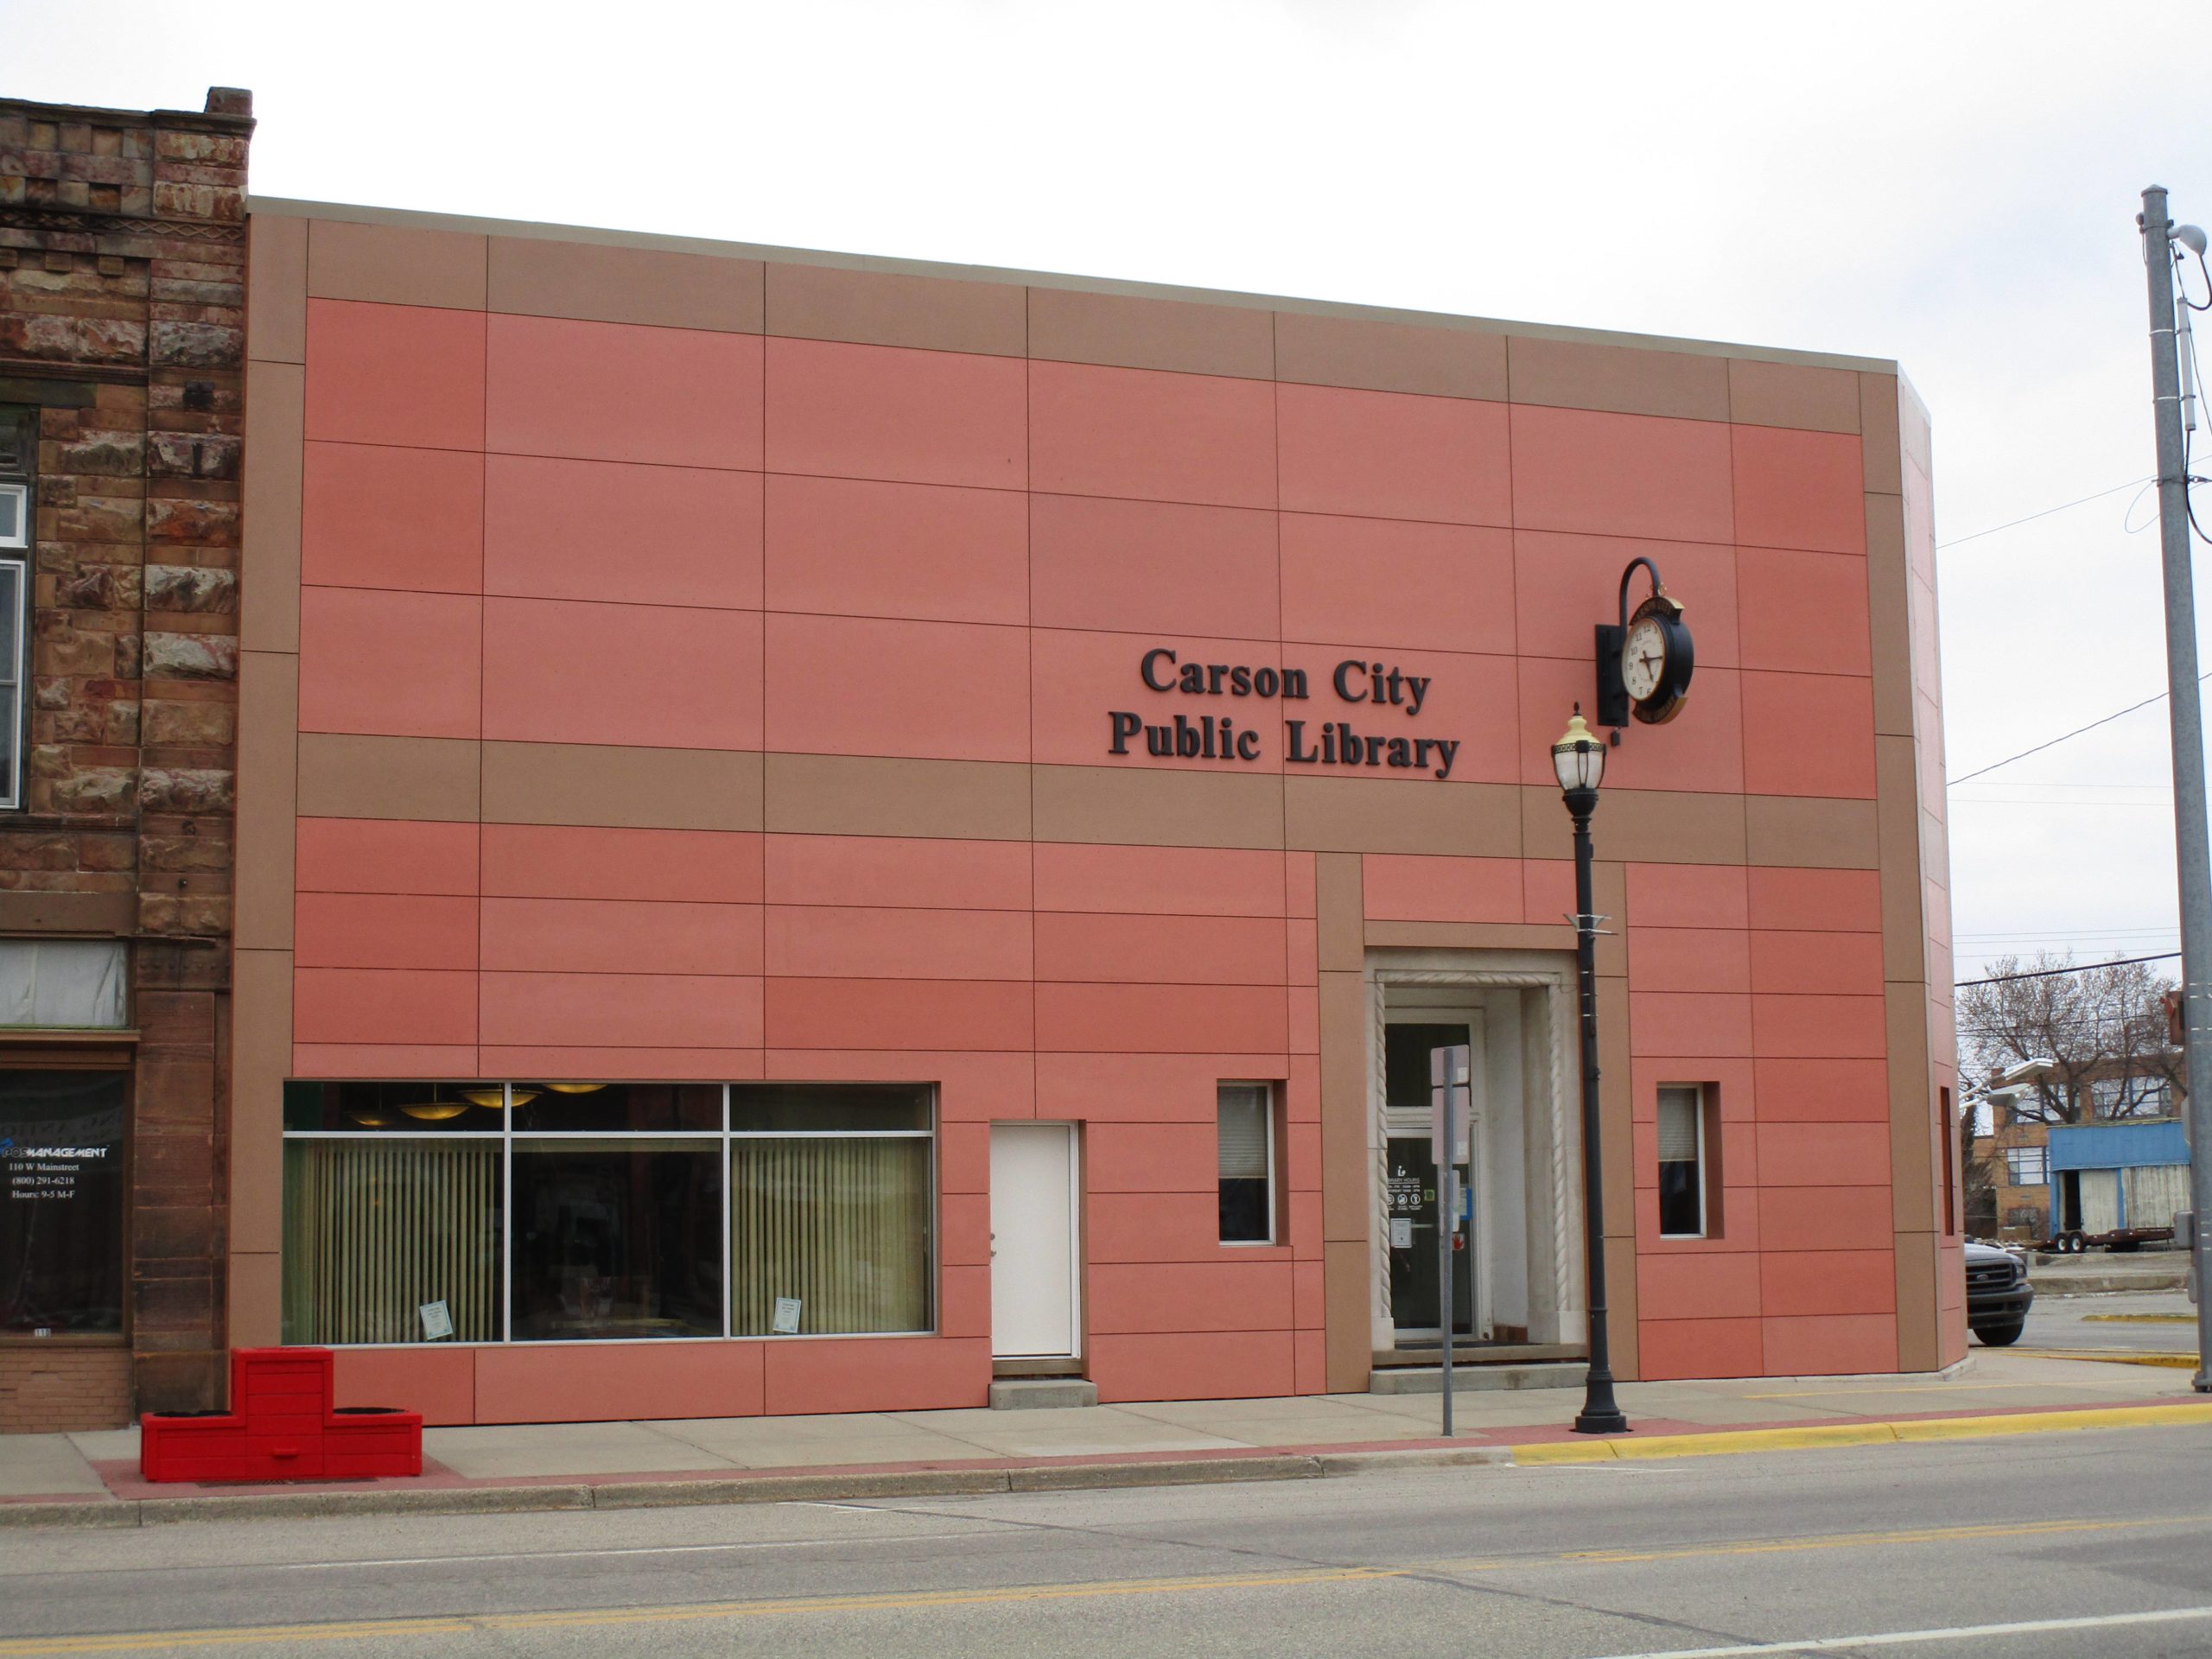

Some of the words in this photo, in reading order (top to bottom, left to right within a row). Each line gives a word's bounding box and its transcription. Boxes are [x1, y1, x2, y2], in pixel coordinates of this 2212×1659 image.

[1630, 646, 1638, 656] 10
[1629, 662, 1634, 671] 9
[1141, 648, 1310, 699] Carson
[1333, 660, 1432, 715] City
[1632, 677, 1637, 685] 8
[1108, 711, 1262, 760] Public
[1284, 720, 1460, 779] Library
[36, 1162, 79, 1171] Mainstreet
[12, 1177, 35, 1185] (800)
